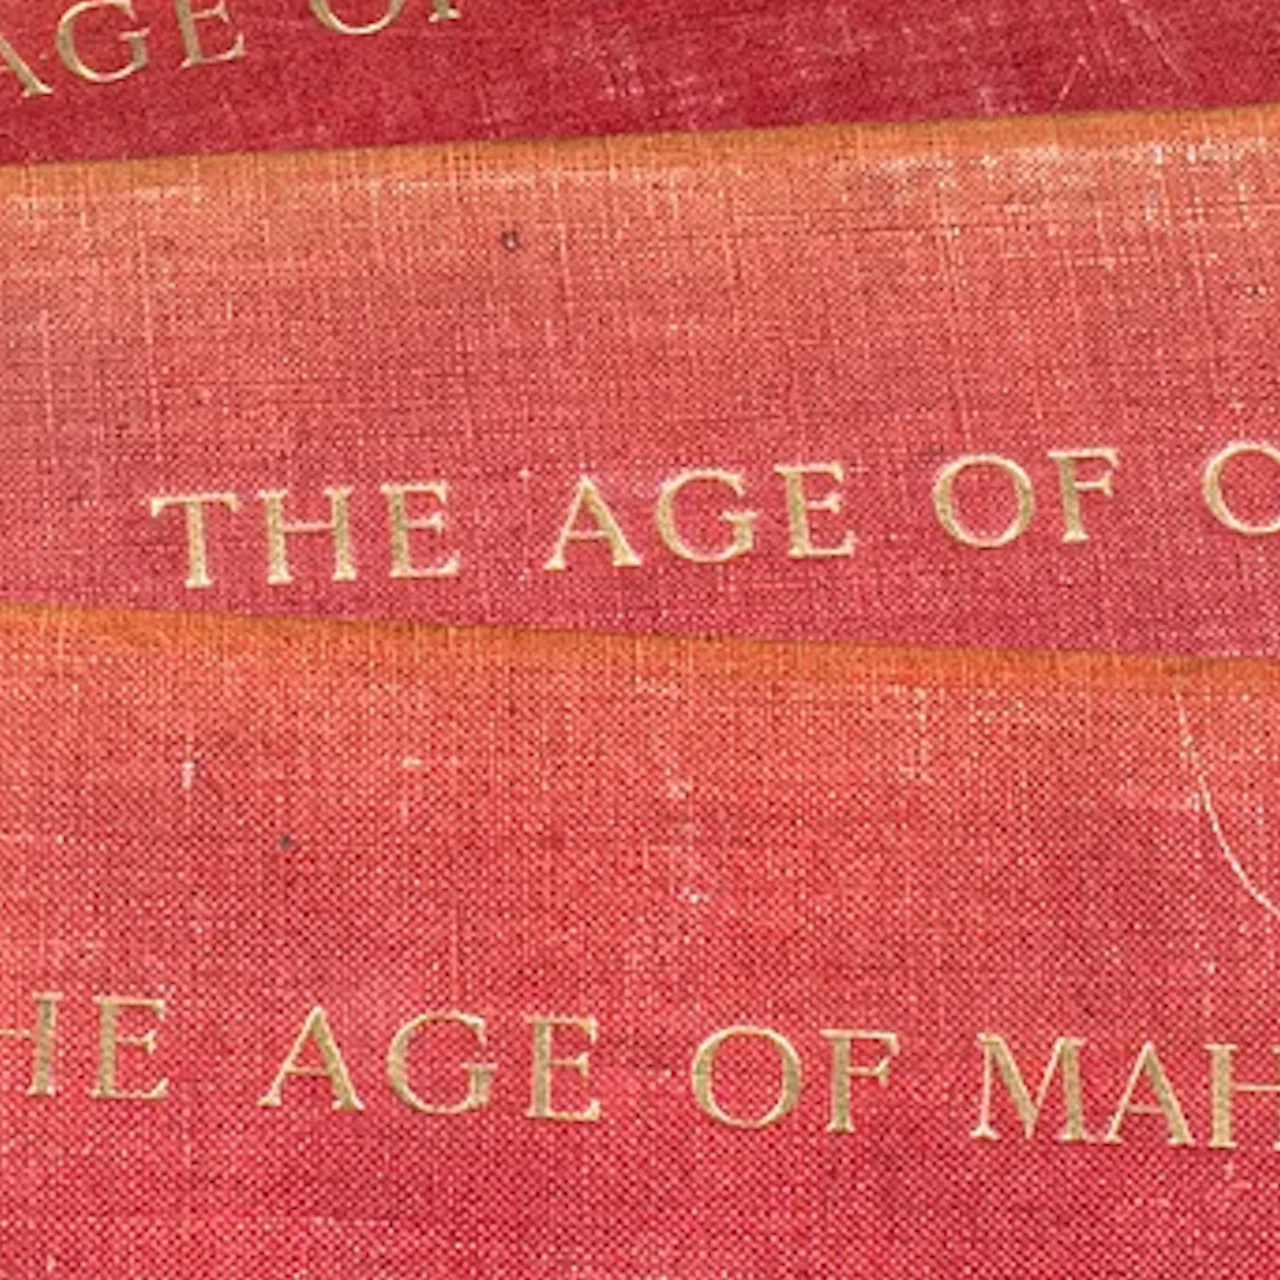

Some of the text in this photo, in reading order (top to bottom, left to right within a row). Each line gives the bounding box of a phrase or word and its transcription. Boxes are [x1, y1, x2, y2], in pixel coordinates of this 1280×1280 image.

[150, 479, 462, 589] THE
[542, 460, 857, 572] AGE
[931, 446, 1120, 549] OF
[256, 1005, 602, 1122] AGE
[690, 1024, 901, 1134] OF
